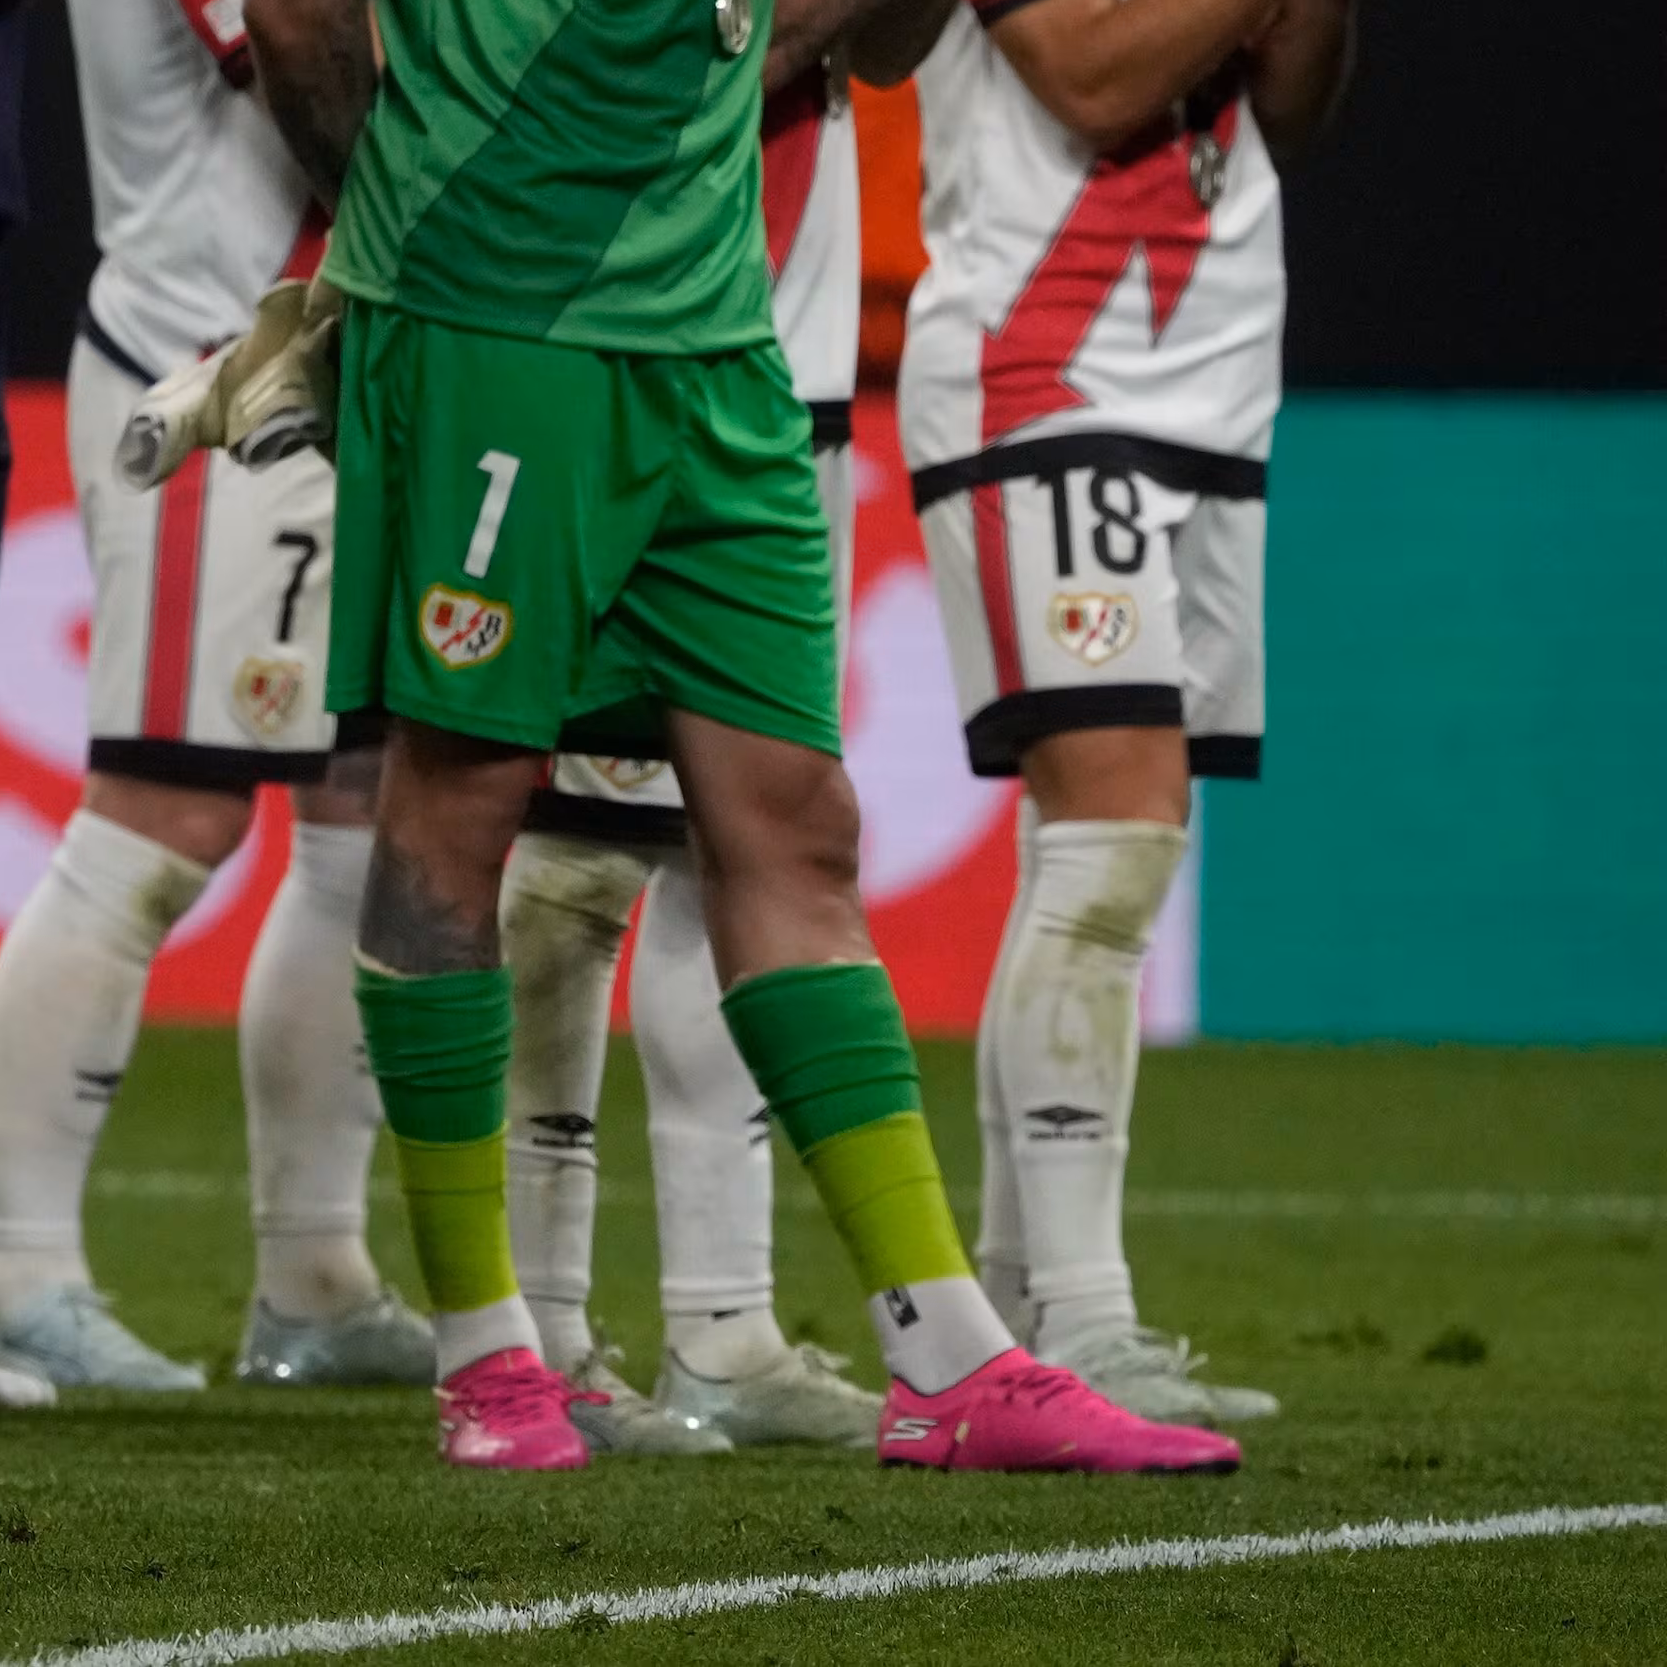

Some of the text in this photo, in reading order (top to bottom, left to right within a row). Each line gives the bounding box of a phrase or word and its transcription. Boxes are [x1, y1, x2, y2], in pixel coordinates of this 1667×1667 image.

[463, 448, 522, 579] 1
[1037, 467, 1146, 576] 18
[275, 531, 319, 643] 7
